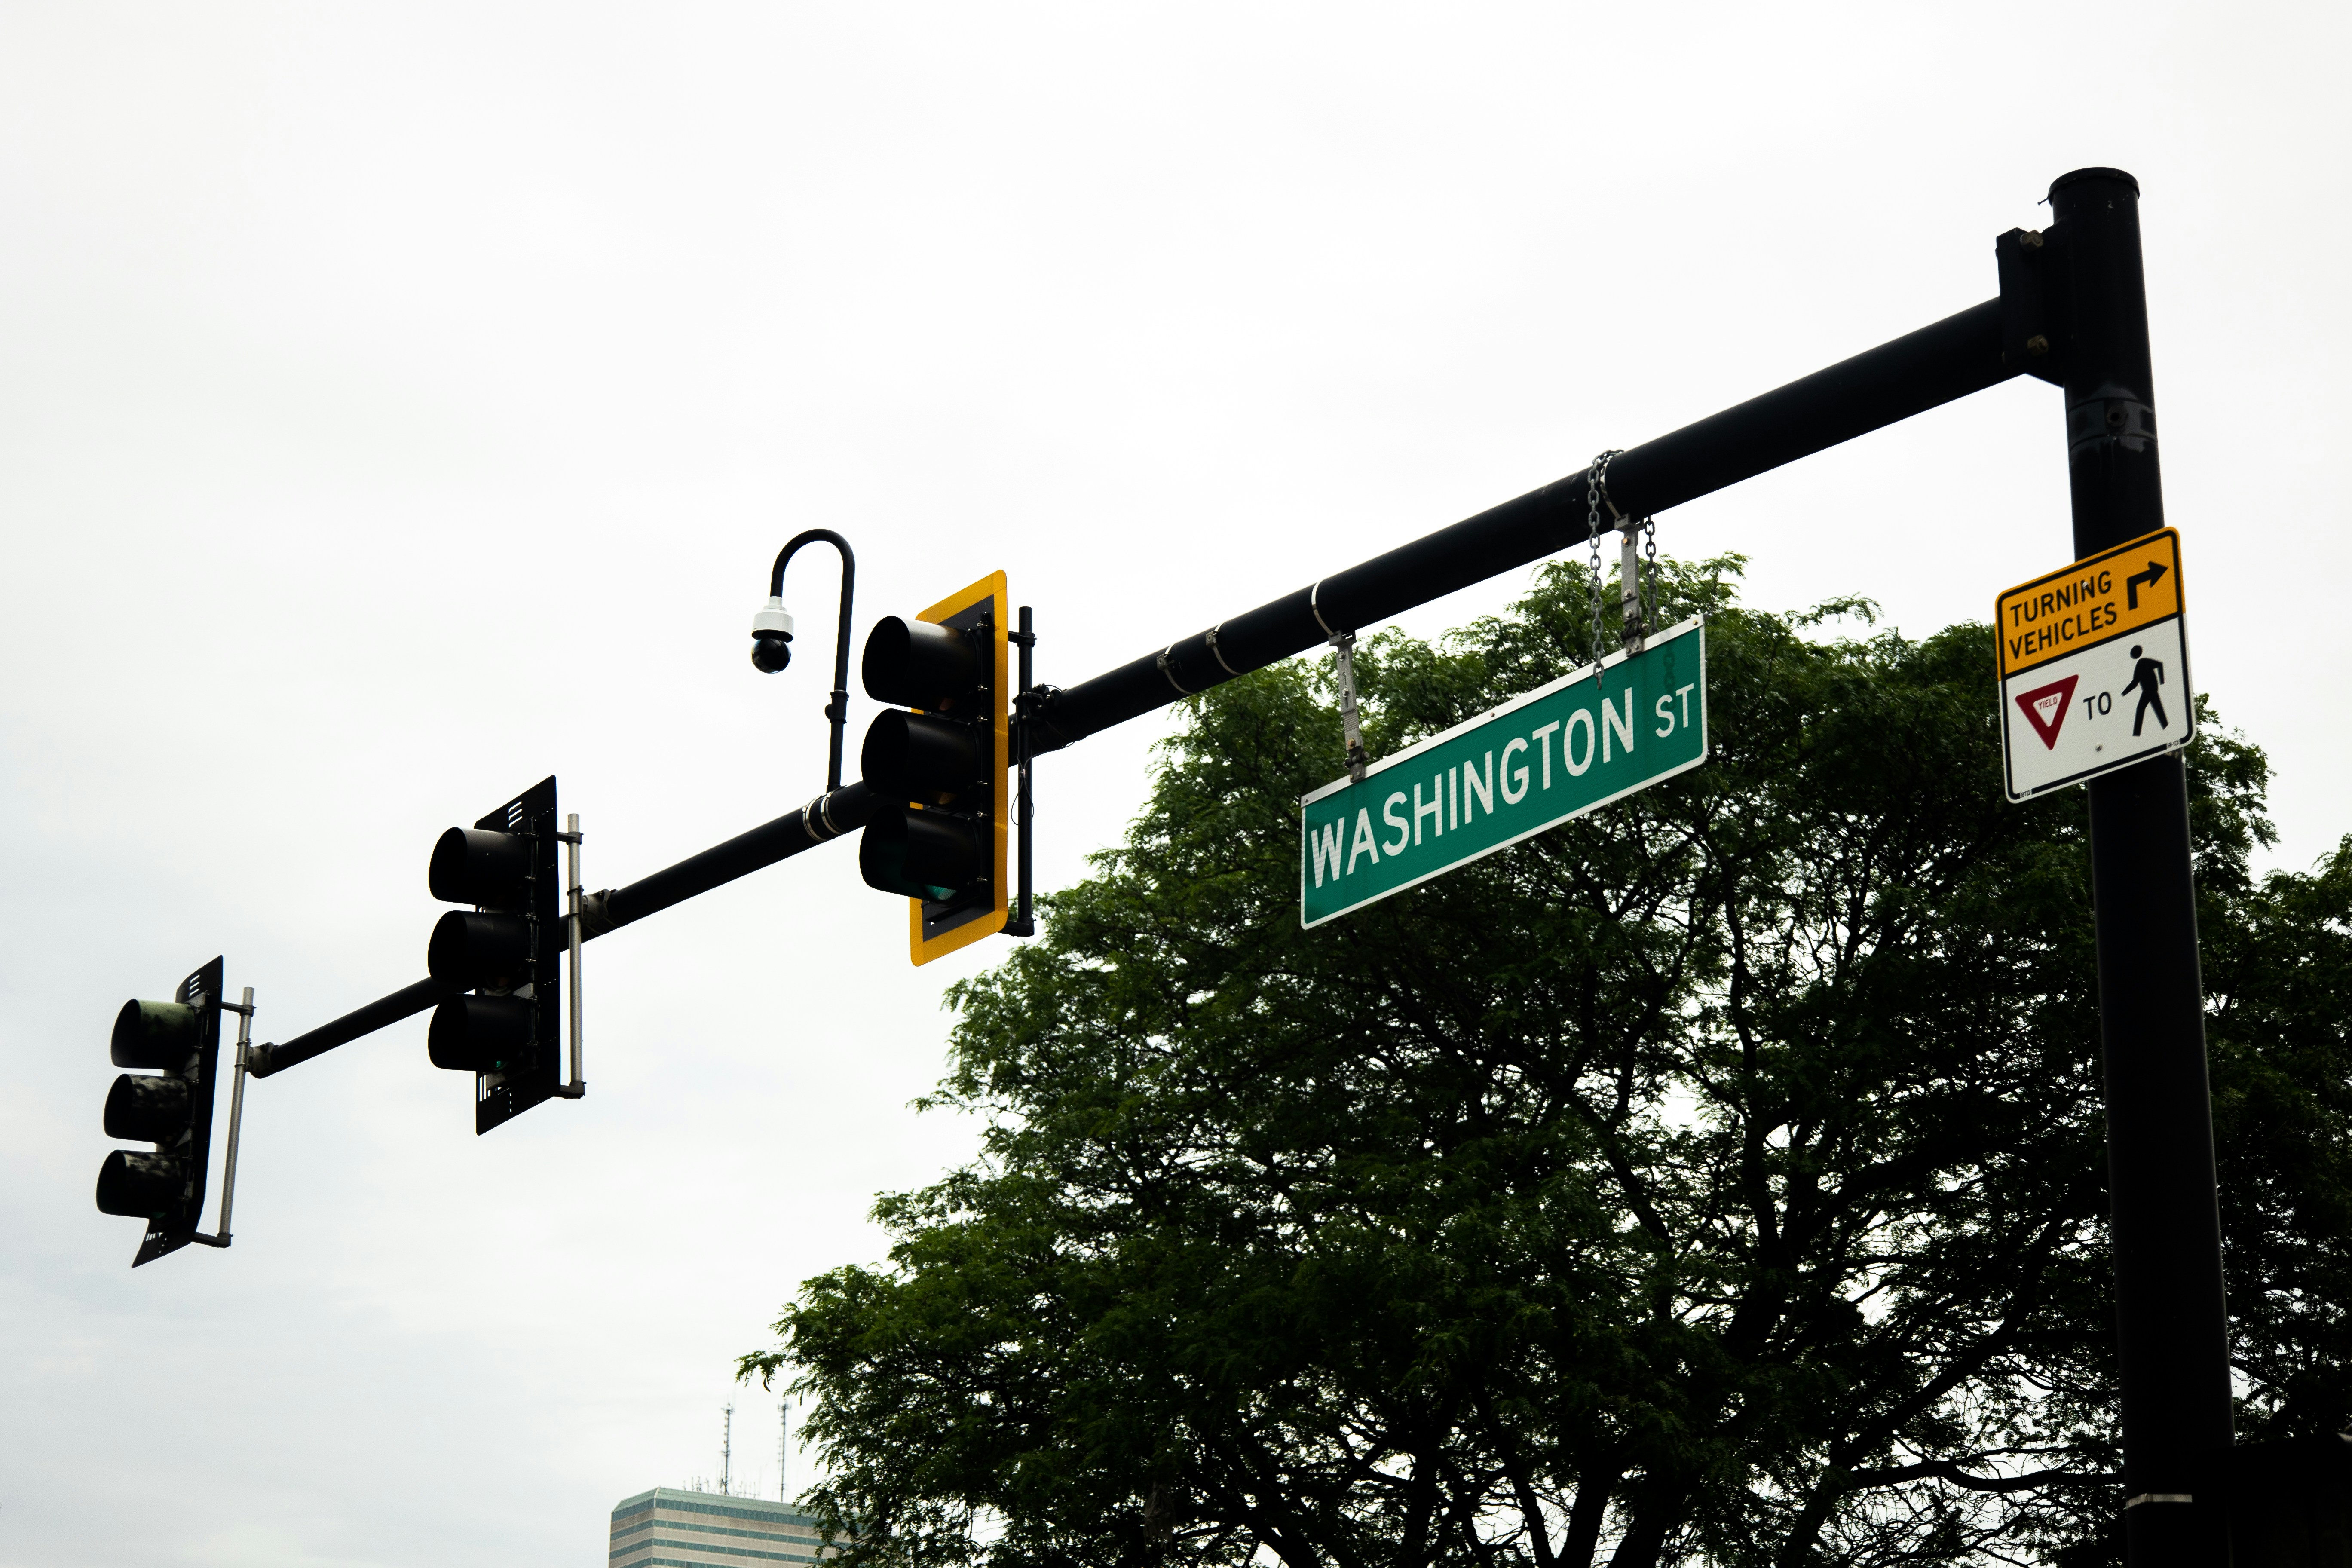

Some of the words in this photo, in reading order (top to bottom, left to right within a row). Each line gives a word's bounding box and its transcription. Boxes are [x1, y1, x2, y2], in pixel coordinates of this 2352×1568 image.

[2010, 571, 2112, 627] TURNING
[2009, 602, 2117, 659] VEHICLES
[2038, 696, 2058, 710] YIELD
[2083, 691, 2112, 720] TO
[1311, 687, 1633, 889] WASHINGTON
[1655, 683, 1694, 738] ST
